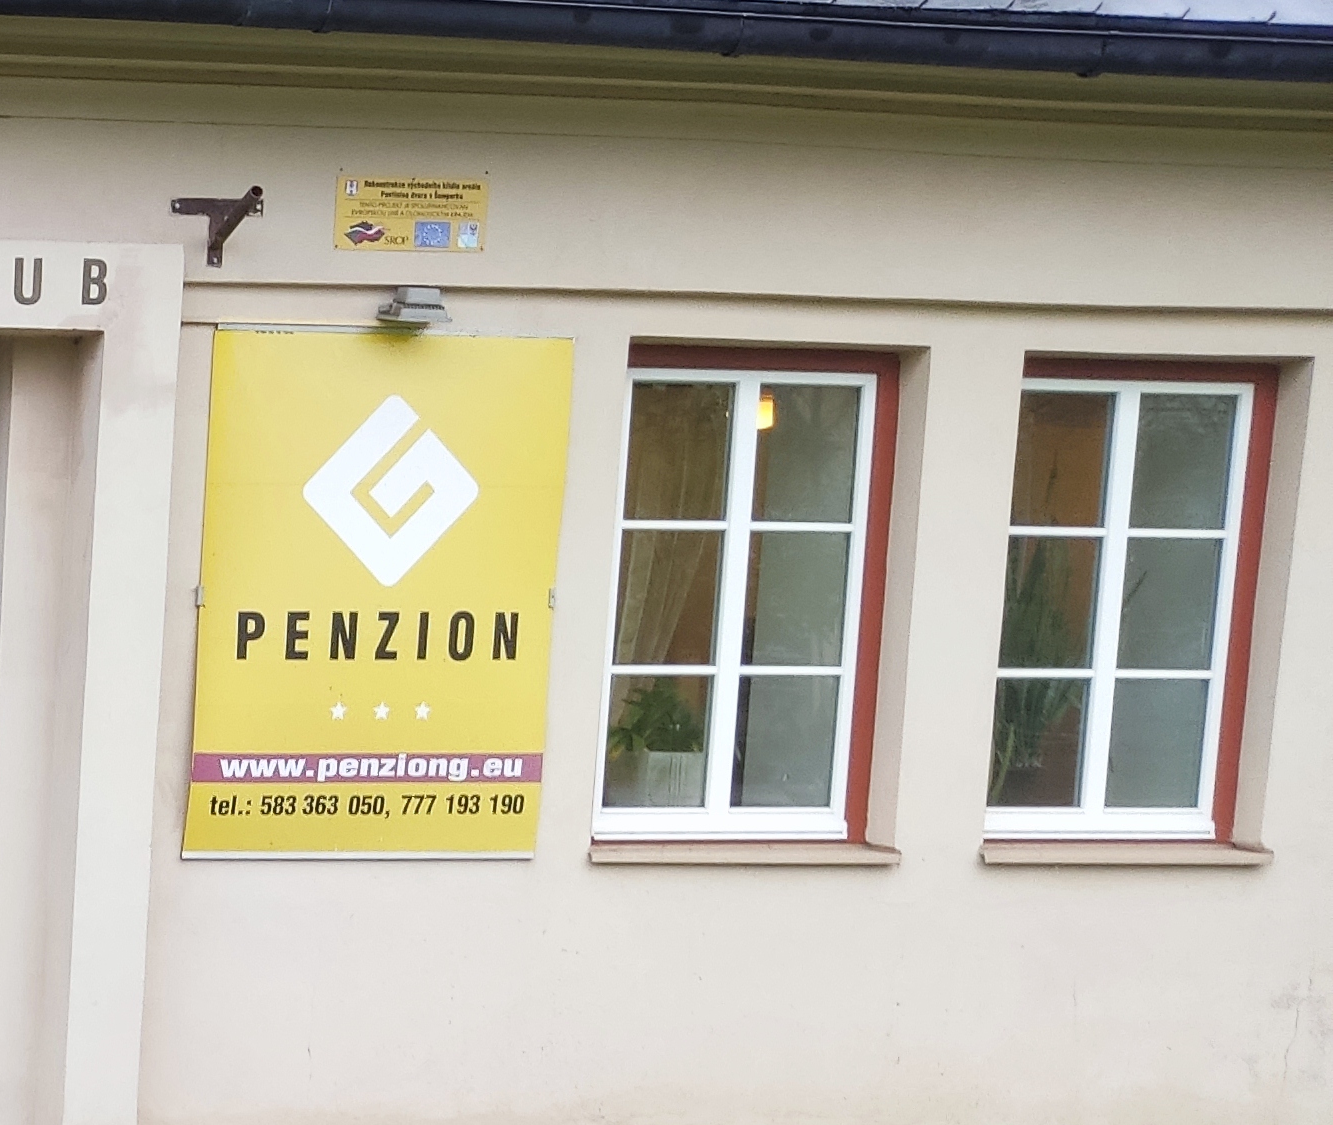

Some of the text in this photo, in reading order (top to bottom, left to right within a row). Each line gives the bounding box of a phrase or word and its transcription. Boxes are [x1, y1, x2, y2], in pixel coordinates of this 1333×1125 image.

[237, 611, 519, 661] PENZION
[220, 753, 523, 782] www.penziong.eu
[210, 794, 525, 819] tel.: 583 363 050, 777 193 190
